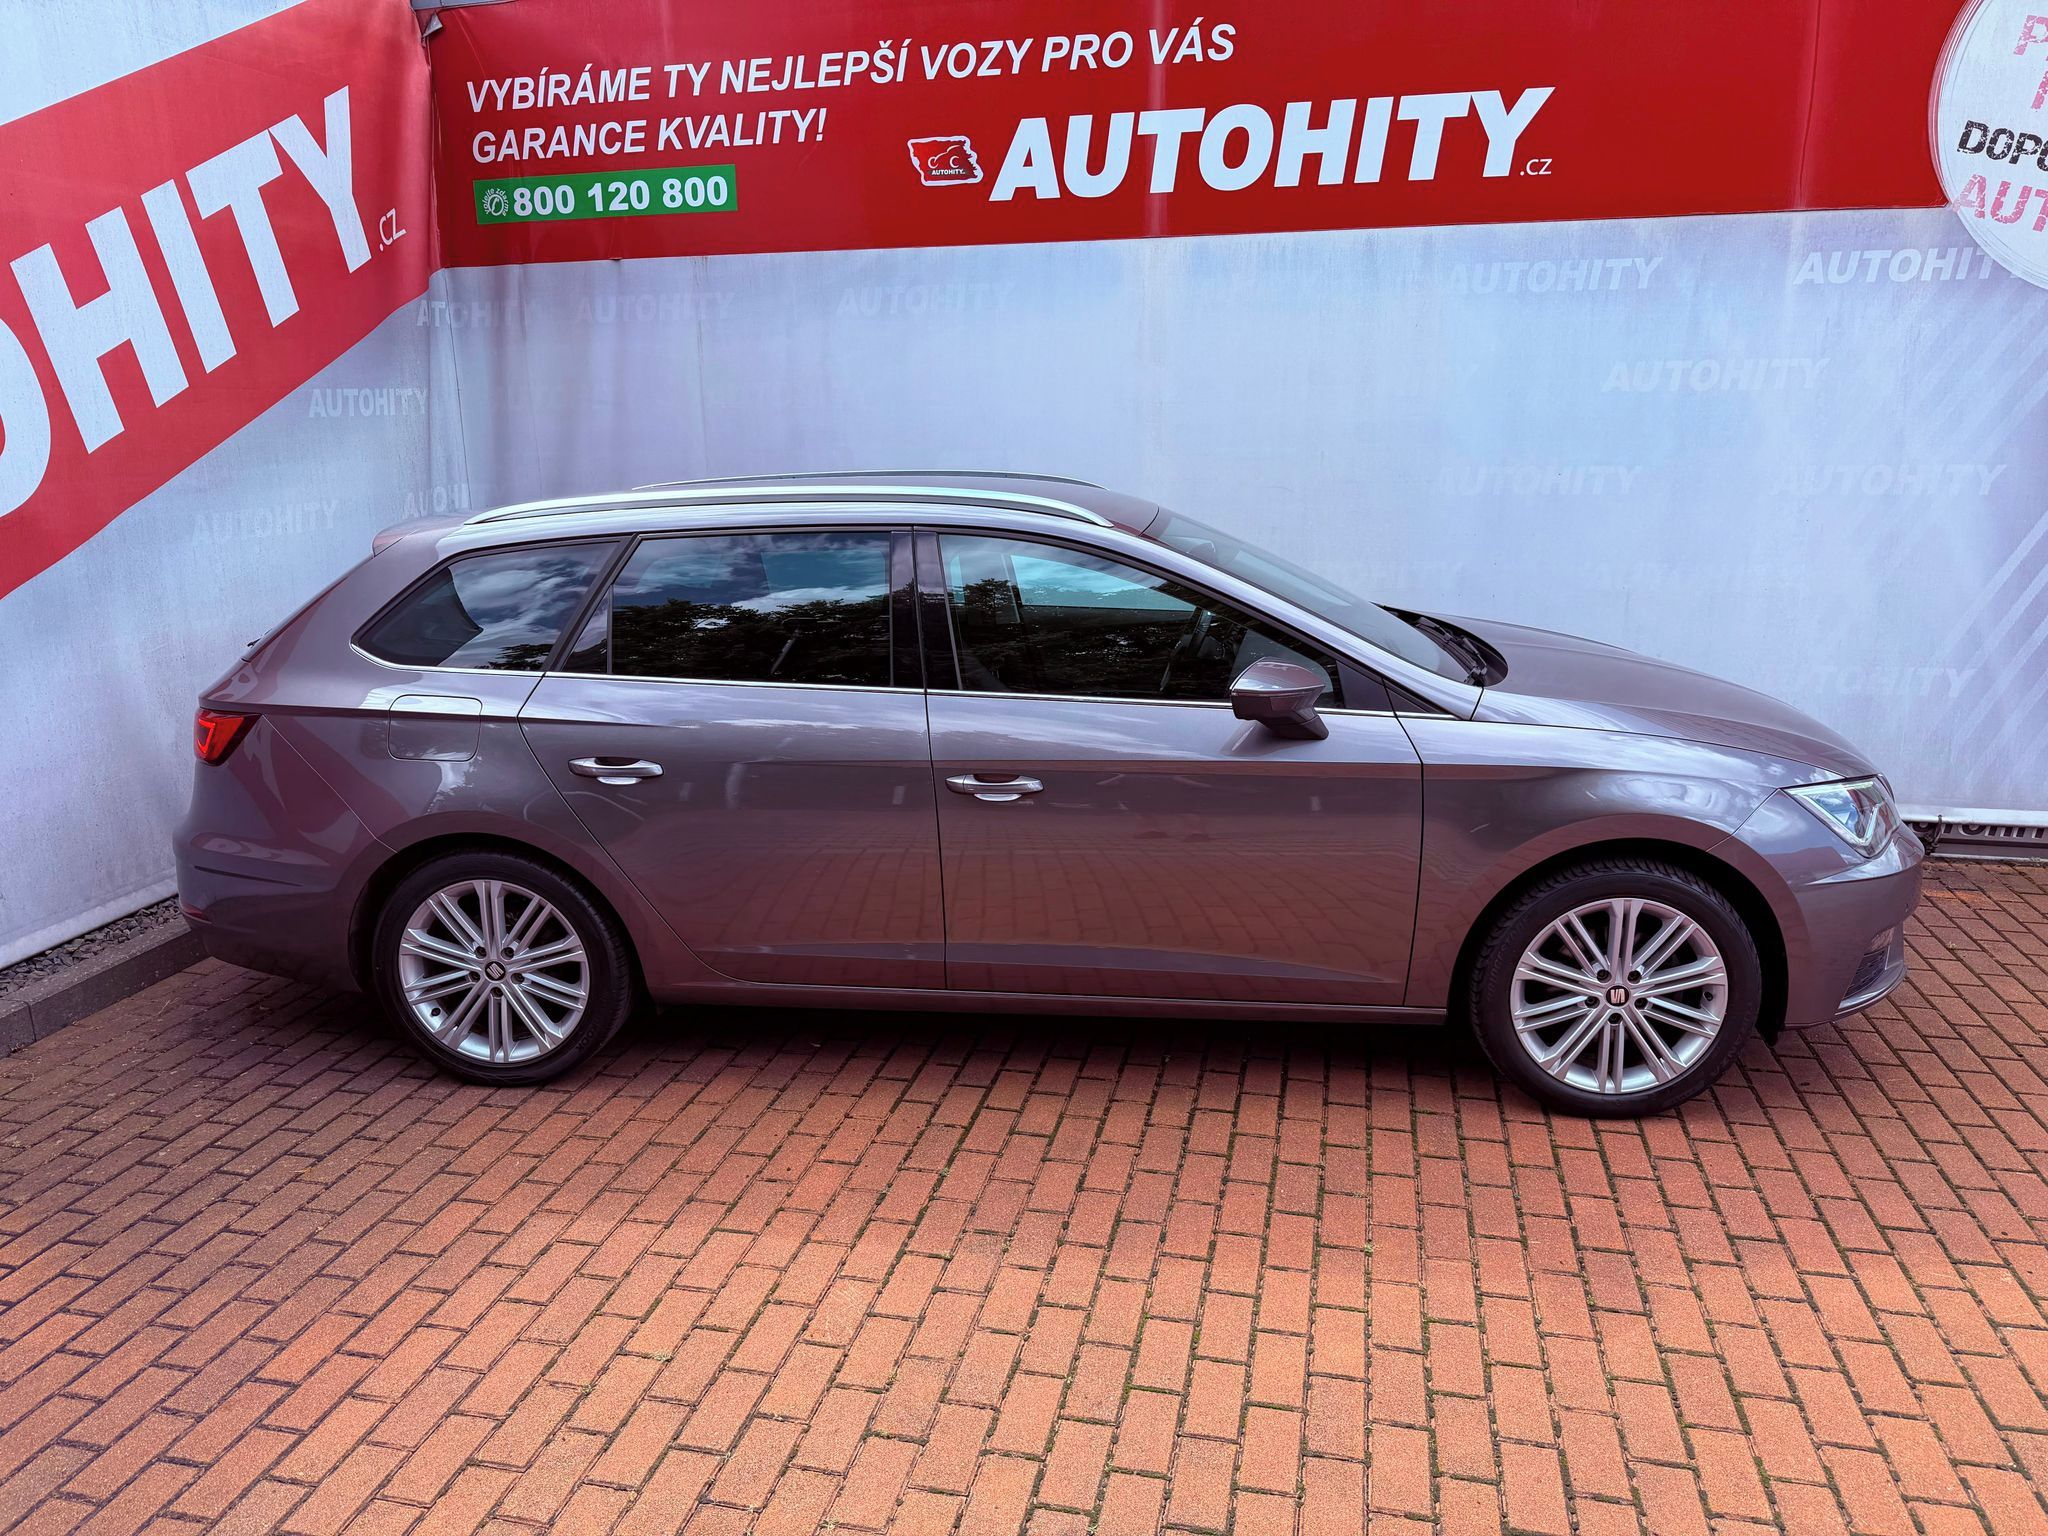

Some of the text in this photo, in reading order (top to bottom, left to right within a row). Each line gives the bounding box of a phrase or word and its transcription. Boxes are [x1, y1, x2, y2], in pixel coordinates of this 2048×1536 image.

[467, 17, 1236, 112] VYBÍRÁME TY NEJLEPŠÍ VOZY PRO VÁS
[473, 107, 827, 163] GARANCE KVALITY!
[989, 87, 1555, 201] AUTOHITY
[513, 176, 728, 217] 800 120 800
[1447, 256, 1664, 294] AUTOHITY
[1792, 247, 2012, 286] AUTOHIT
[1601, 357, 1831, 393] AUTOHITY
[308, 387, 427, 418] AUTOHITY
[1770, 464, 2007, 497] AUTOHITY
